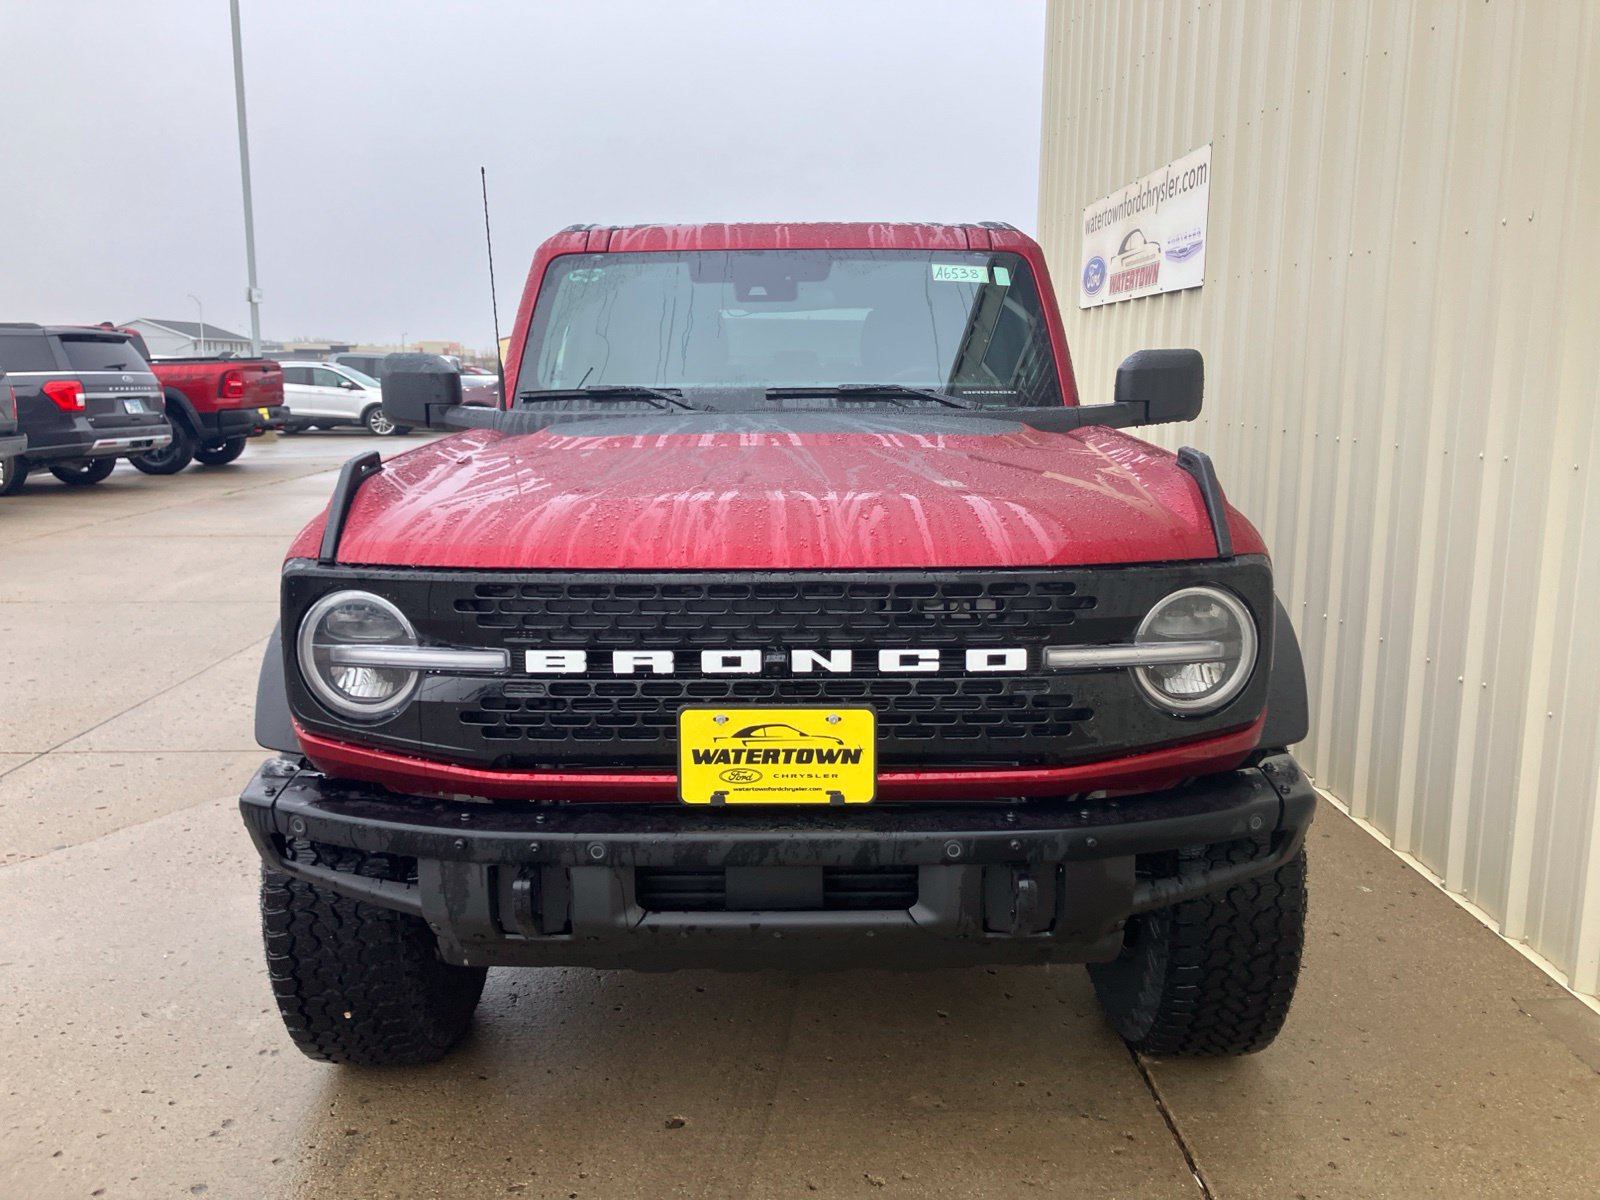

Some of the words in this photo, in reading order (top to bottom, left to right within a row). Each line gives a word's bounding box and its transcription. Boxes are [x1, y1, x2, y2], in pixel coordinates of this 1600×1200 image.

[1085, 162, 1207, 236] watertownfordchrysler.com
[935, 266, 979, 279] A6538
[1109, 260, 1161, 295] WATERTOWN
[525, 648, 1028, 674] BRONCO
[691, 748, 863, 765] WATERTOWN
[728, 770, 754, 781] Ford
